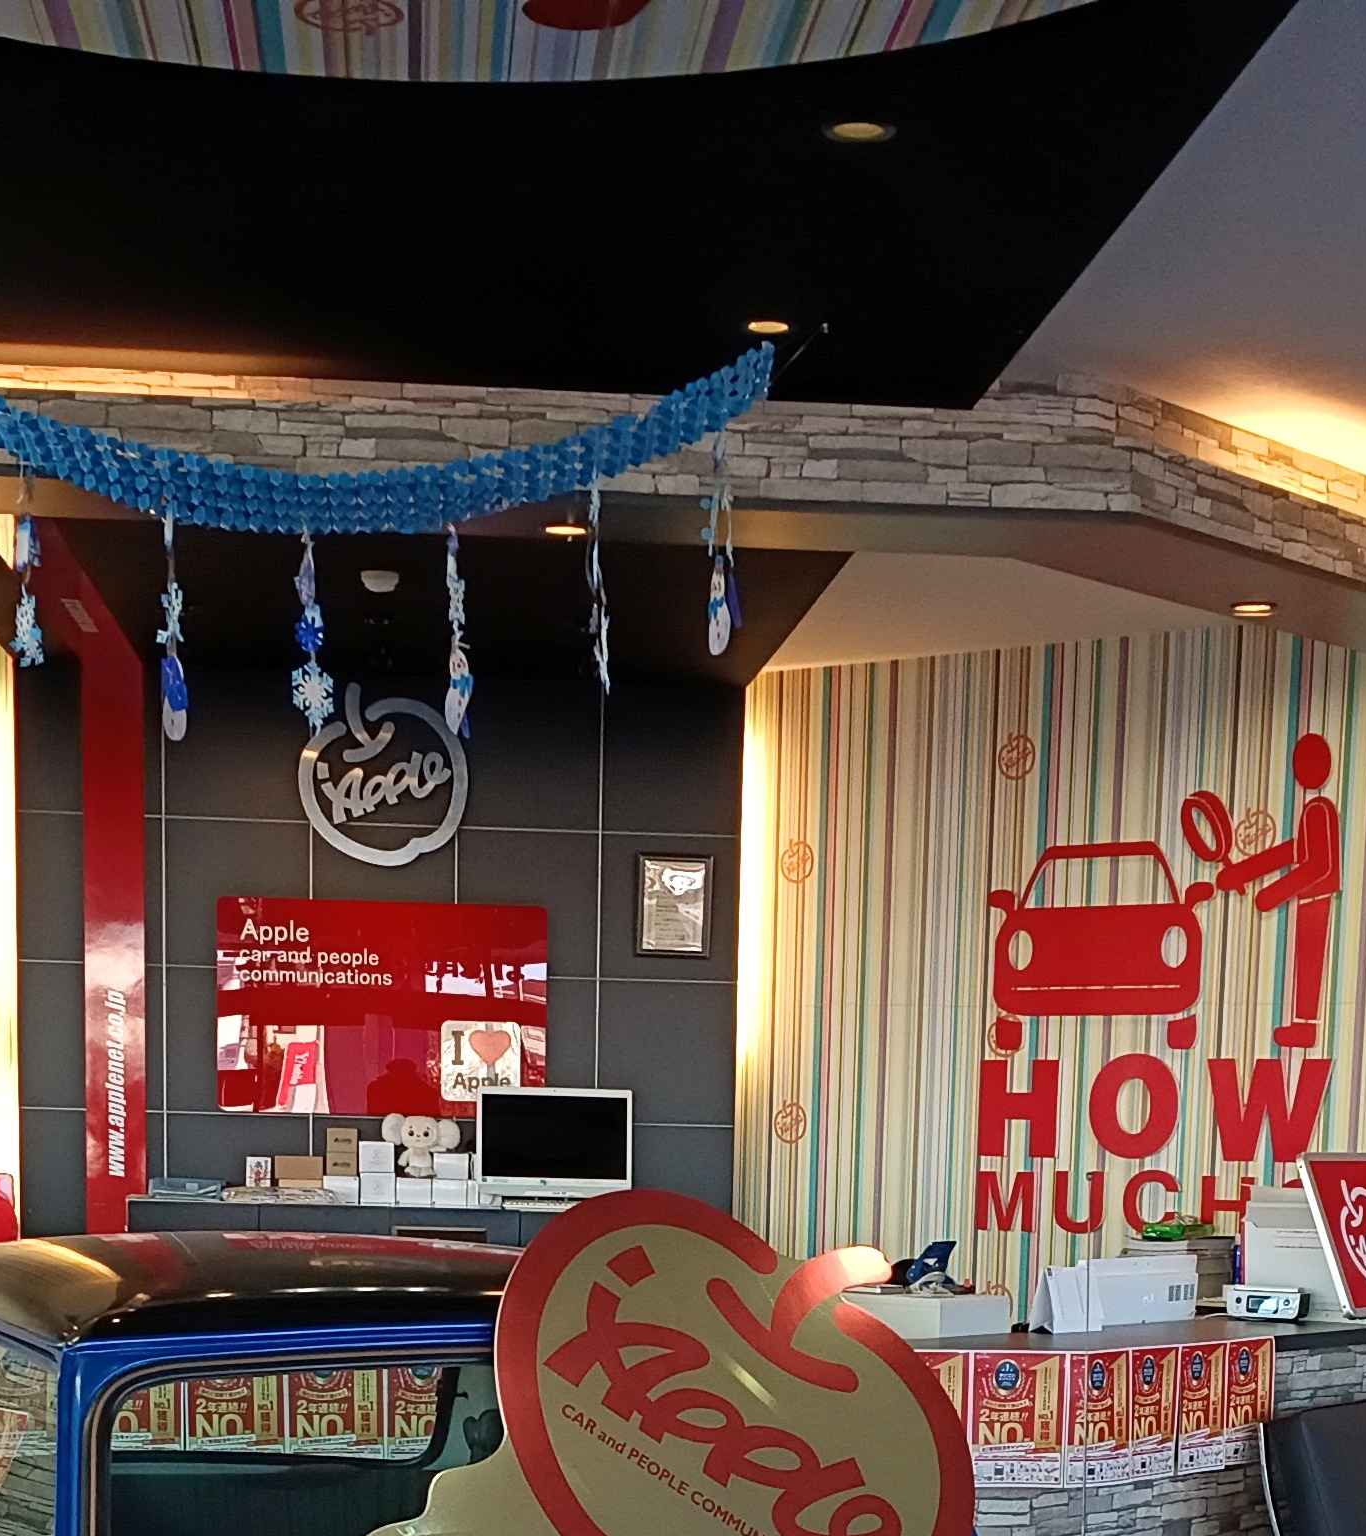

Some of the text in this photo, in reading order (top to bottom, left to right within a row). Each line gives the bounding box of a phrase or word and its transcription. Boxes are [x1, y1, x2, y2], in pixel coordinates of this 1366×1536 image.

[239, 918, 310, 945] Apple
[239, 946, 379, 969] car and people
[238, 968, 393, 986] communications
[451, 1029, 465, 1066] I
[105, 988, 128, 1178] www.applenet.co.jp
[452, 1072, 511, 1092] Apple
[977, 1053, 1333, 1162] HOW
[975, 1169, 1303, 1236] MUCH
[195, 1413, 252, 1438] NO.
[297, 1414, 353, 1438] NO.
[978, 1422, 1031, 1446] NO.
[560, 1403, 597, 1435] CAR
[597, 1430, 627, 1456] and
[627, 1446, 690, 1498] PEOPLE
